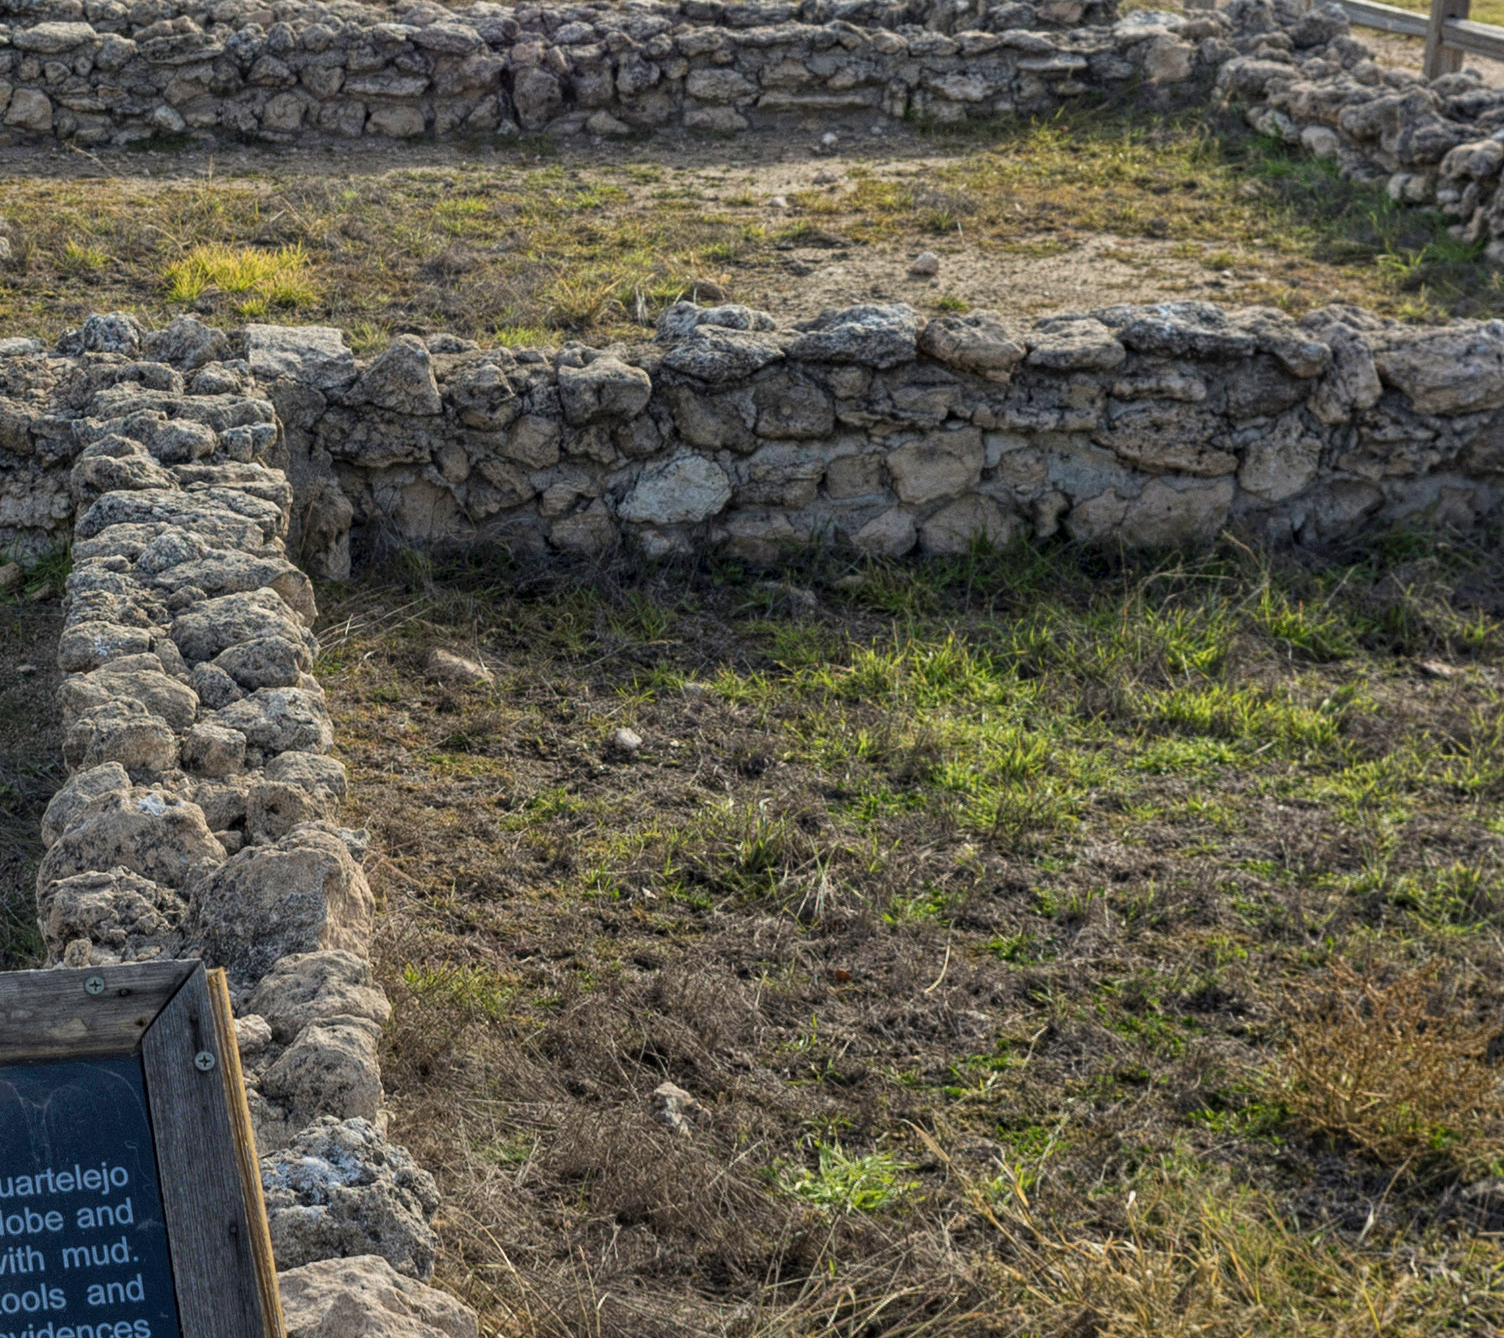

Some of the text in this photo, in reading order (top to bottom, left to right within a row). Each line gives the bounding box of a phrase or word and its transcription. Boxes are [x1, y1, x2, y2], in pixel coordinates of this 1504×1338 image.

[76, 1196, 134, 1229] and
[61, 1235, 140, 1269] mud.
[86, 1273, 145, 1306] and
